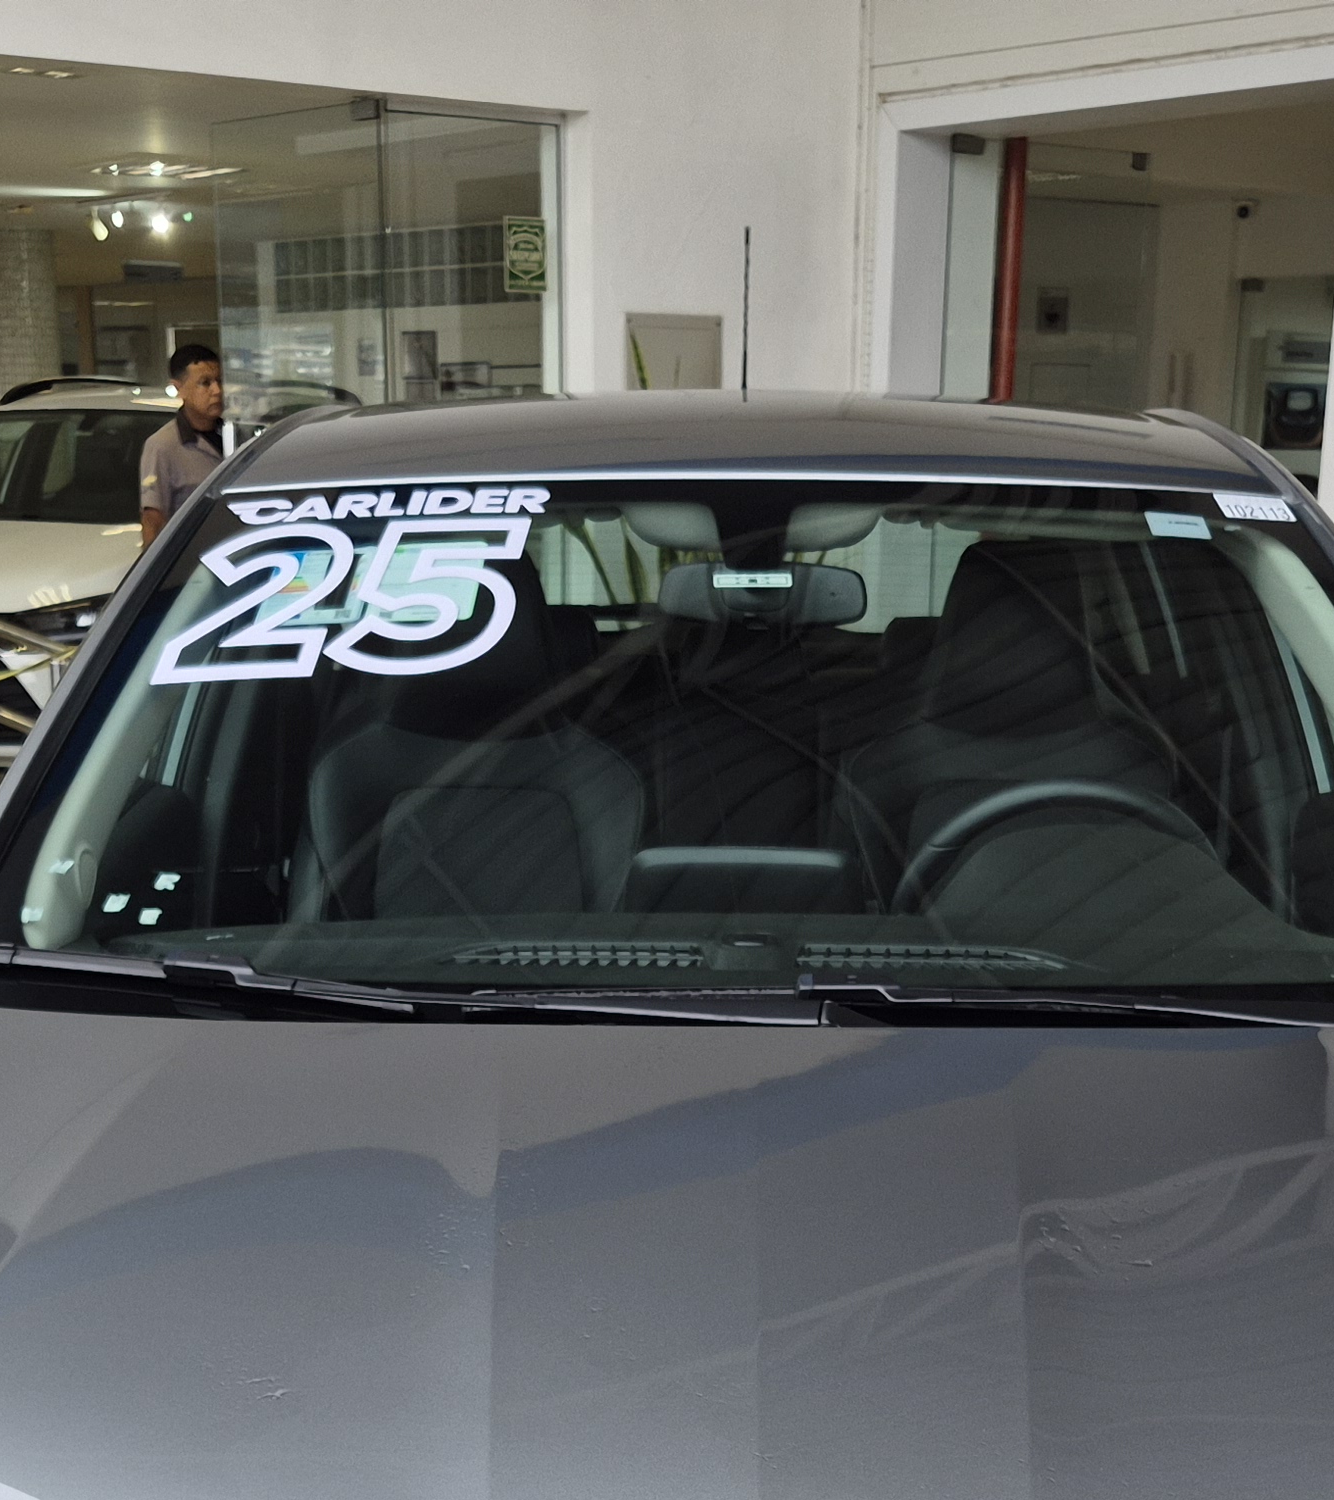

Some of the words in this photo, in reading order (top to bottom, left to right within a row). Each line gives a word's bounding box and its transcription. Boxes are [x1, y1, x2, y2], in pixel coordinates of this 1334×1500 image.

[227, 488, 551, 525] CARLIDER
[1225, 504, 1291, 521] 102113
[149, 517, 532, 685] 25
